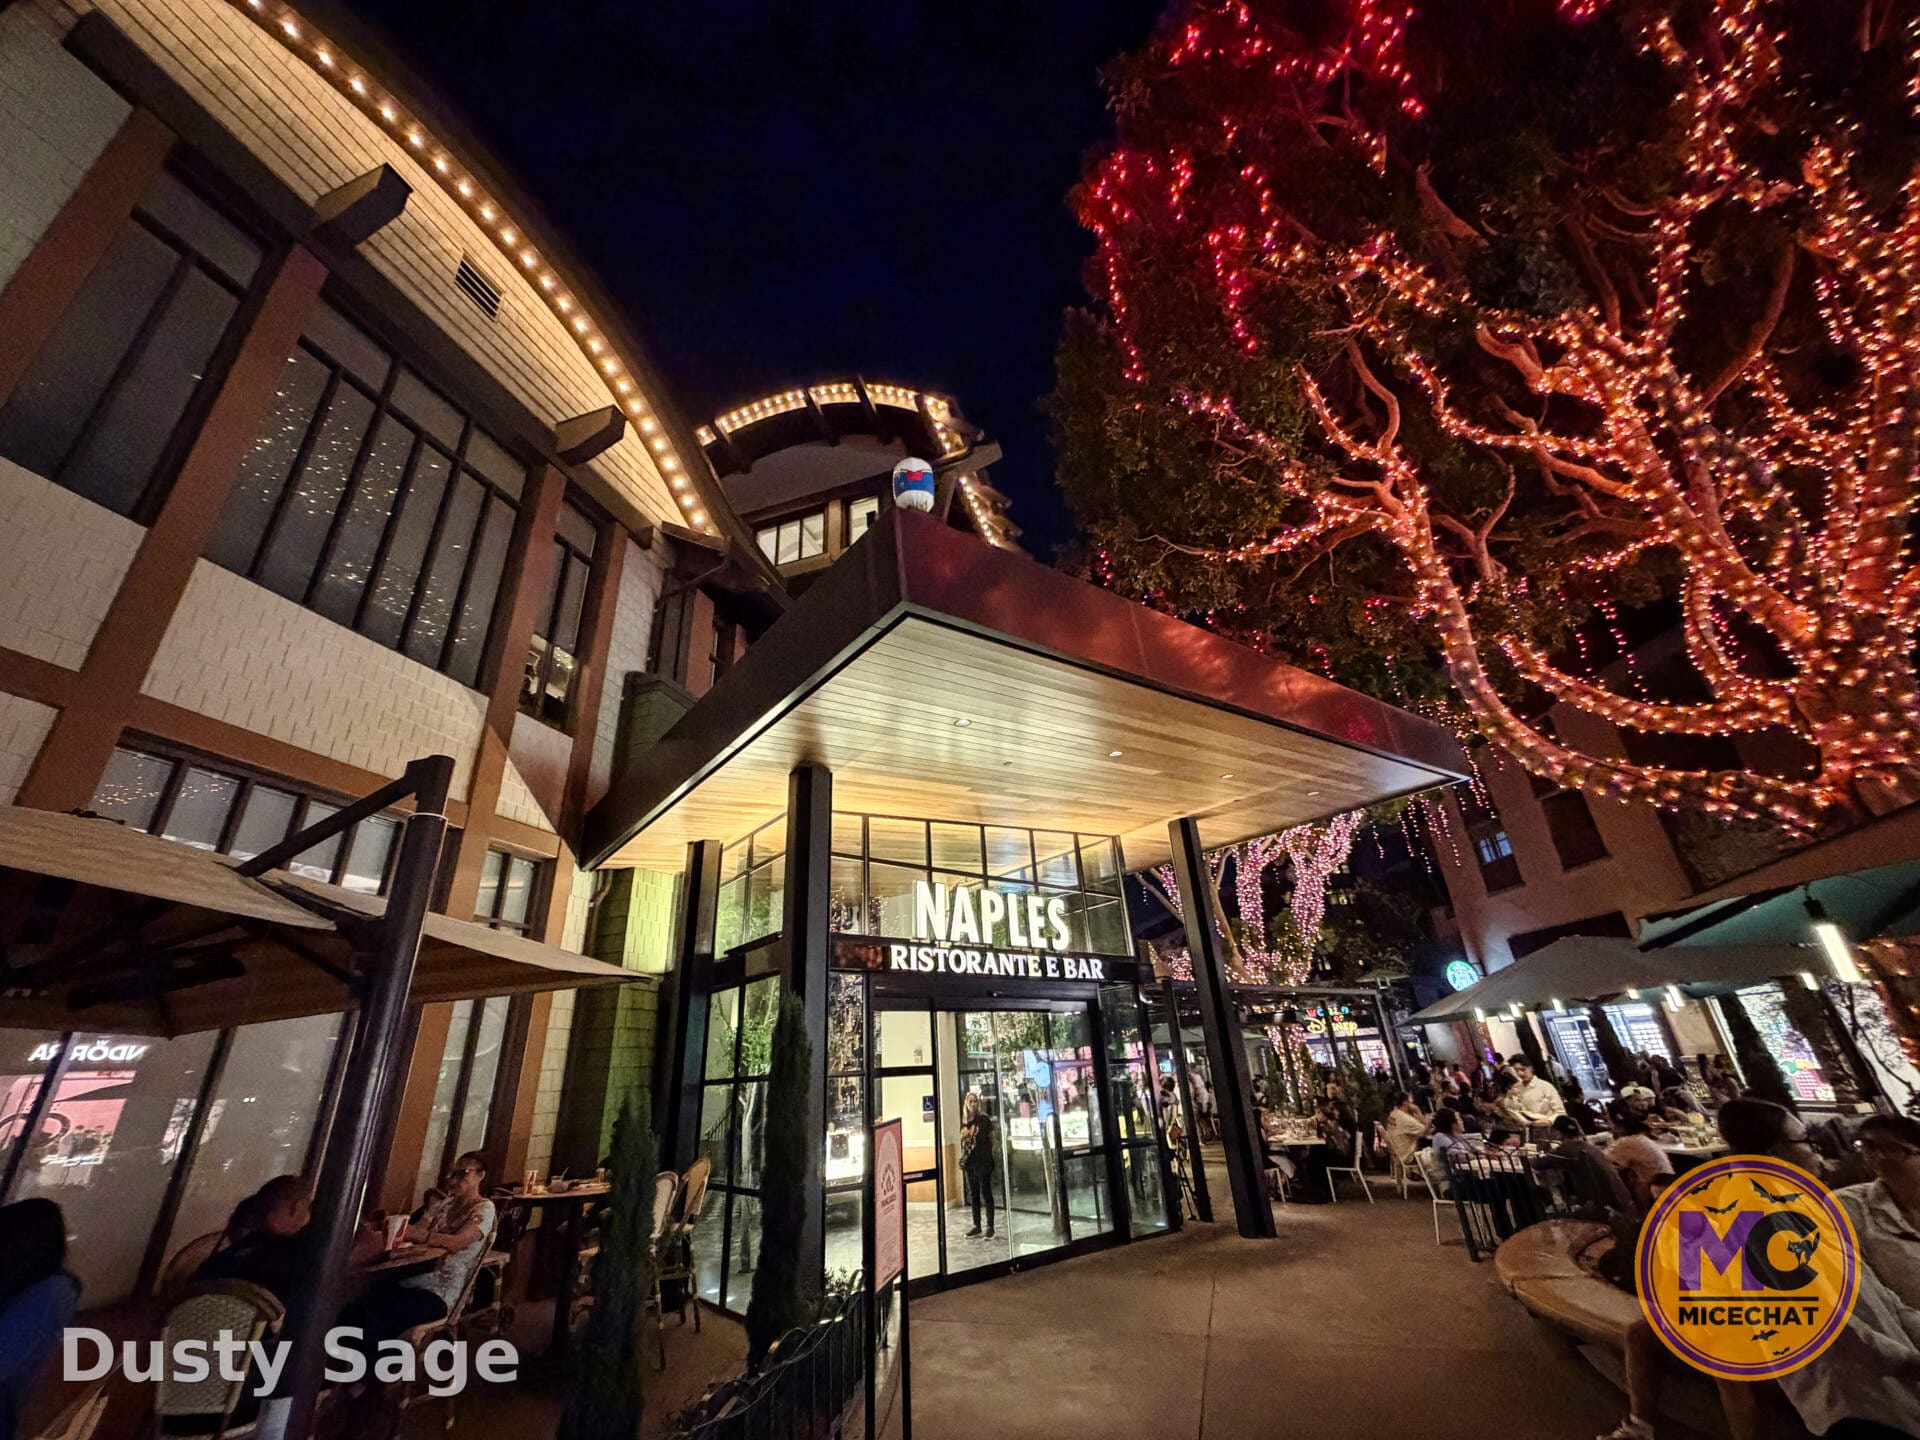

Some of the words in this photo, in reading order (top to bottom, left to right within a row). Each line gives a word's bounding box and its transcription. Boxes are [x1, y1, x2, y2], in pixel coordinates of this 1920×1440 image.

[913, 880, 1071, 951] NAPLES
[890, 945, 1042, 977] RISTORANTE
[1046, 956, 1060, 978] E
[1063, 957, 1105, 980] BAR
